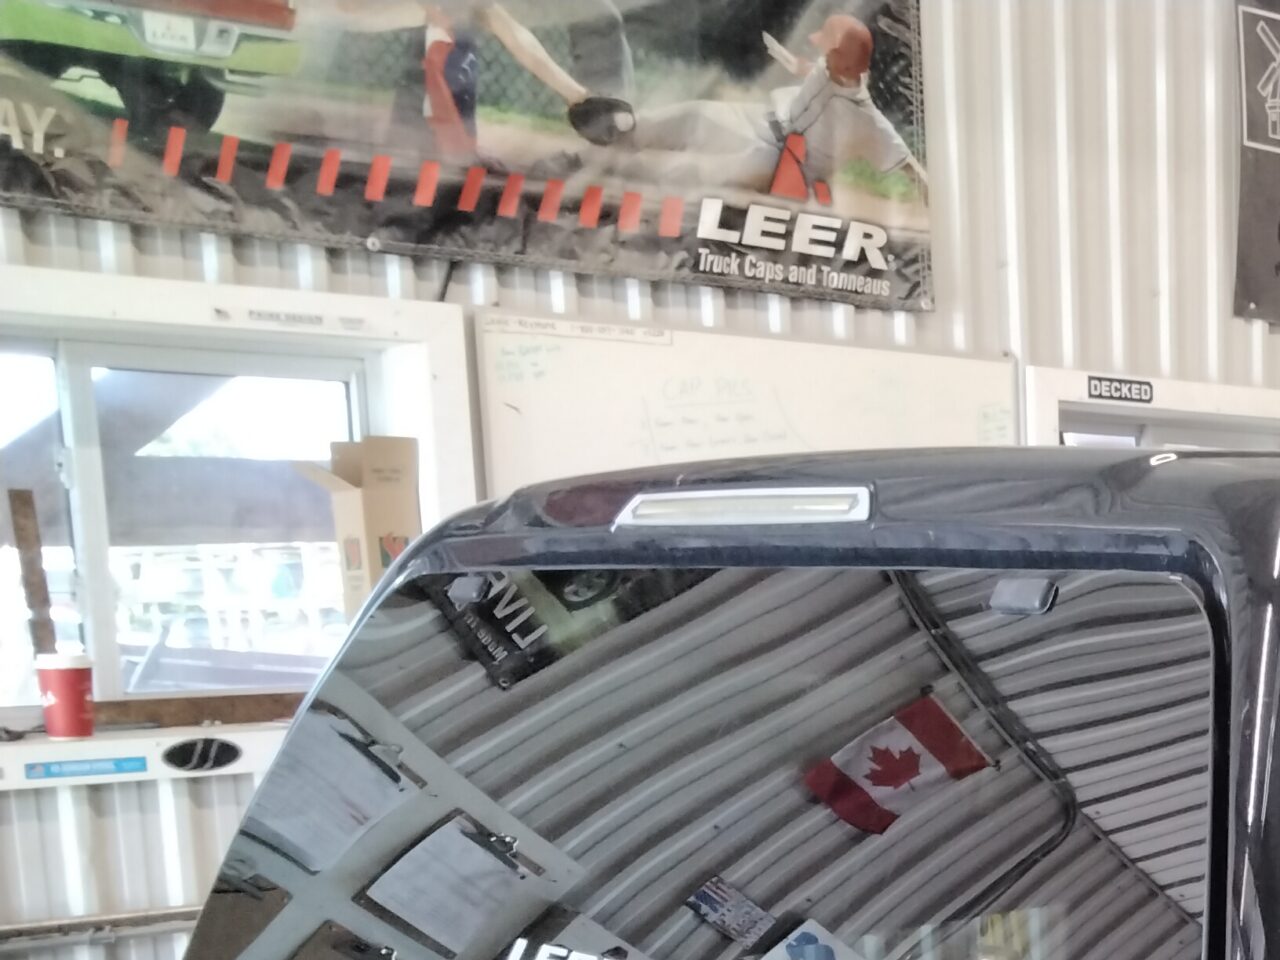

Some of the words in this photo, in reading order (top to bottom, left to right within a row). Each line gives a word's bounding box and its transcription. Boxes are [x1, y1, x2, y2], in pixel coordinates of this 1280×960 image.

[697, 197, 888, 271] LEER
[698, 248, 740, 276] Truck
[744, 255, 784, 283] Caps
[788, 264, 817, 286] and
[821, 266, 891, 297] Tonneaus
[1090, 379, 1151, 401] DECKED
